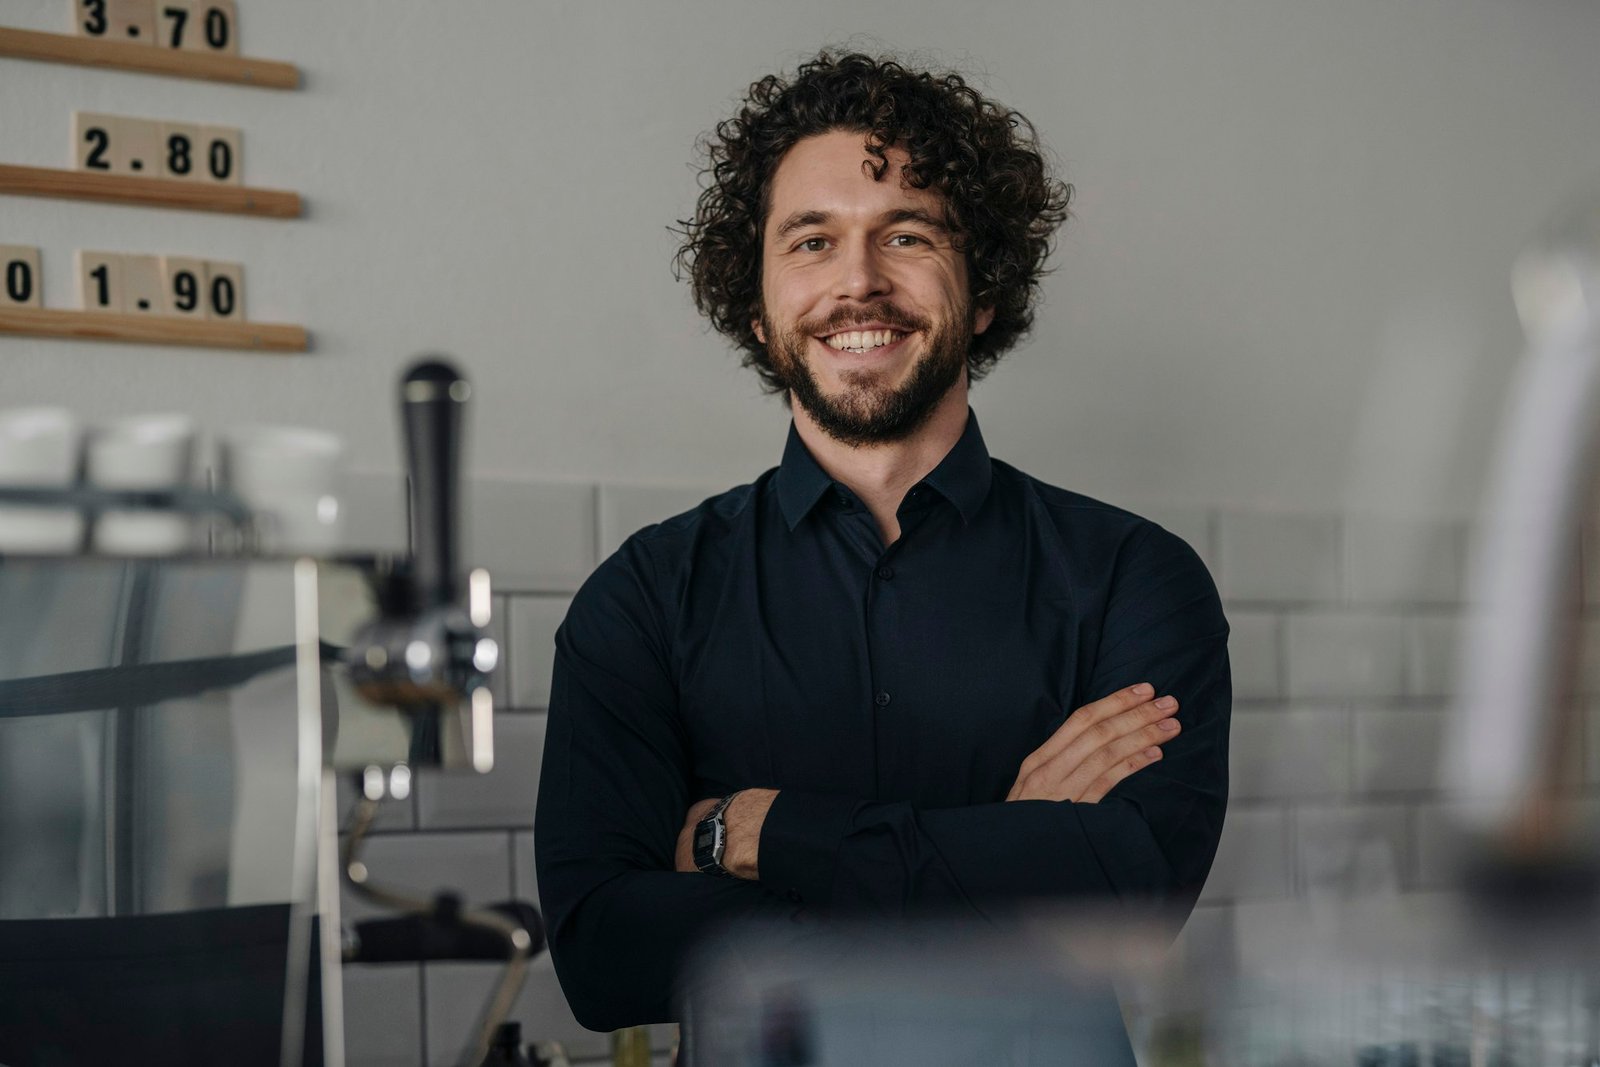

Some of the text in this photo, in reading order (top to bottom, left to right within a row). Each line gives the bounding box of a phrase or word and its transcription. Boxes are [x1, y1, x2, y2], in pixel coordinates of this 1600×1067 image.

[83, 0, 228, 49] 3.70
[84, 127, 232, 179] 2.80
[89, 264, 235, 316] 1.90
